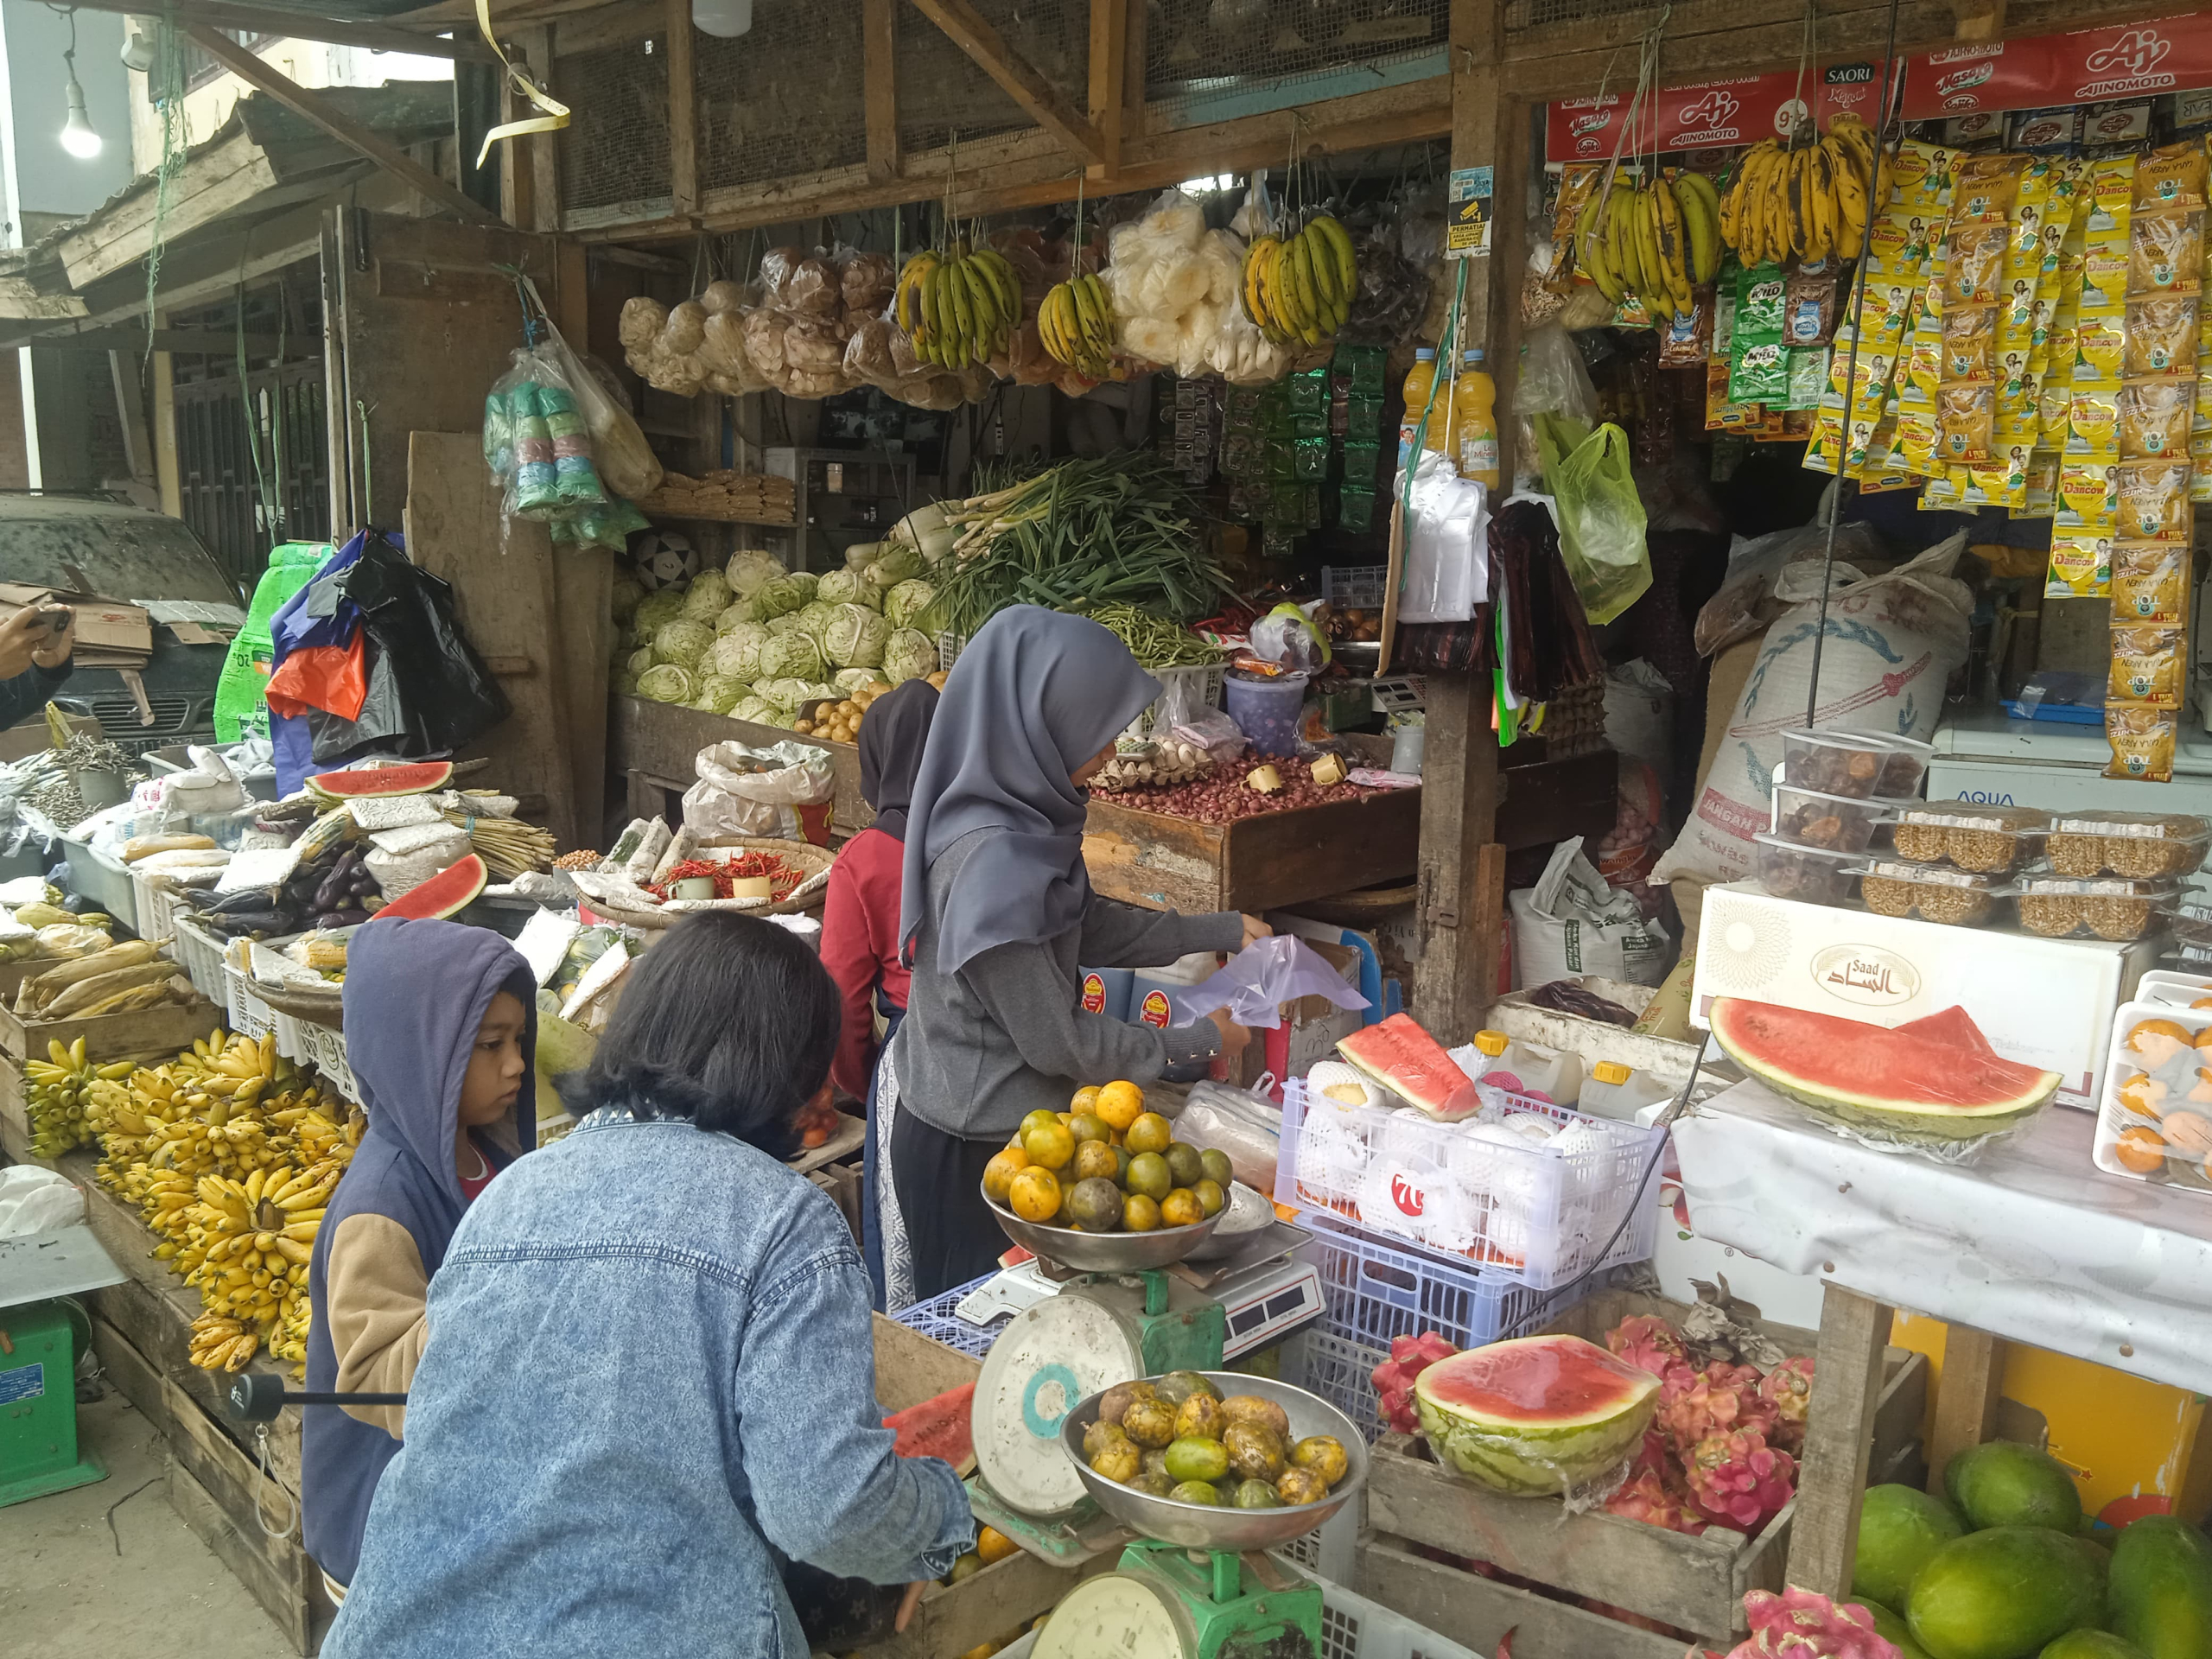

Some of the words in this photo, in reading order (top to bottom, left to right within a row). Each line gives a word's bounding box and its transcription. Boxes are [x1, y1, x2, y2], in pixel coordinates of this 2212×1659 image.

[1827, 68, 1871, 83] SAORI
[2075, 74, 2175, 97] AJINOMOTO
[1671, 129, 1738, 144] AJINOMOTO
[2095, 184, 2133, 196] Danco
[2154, 178, 2185, 191] TOP
[1870, 229, 1906, 243] Dancow
[1833, 367, 1869, 381] Dacow
[2073, 410, 2114, 422] Dancow
[2063, 482, 2106, 495] Dancow
[2135, 512, 2165, 524] TOP
[2054, 553, 2096, 567] Dancow
[2131, 594, 2161, 606] TOP
[2126, 675, 2157, 686] TOP
[2122, 753, 2152, 766] TOP
[1956, 790, 2014, 807] AQUA
[1852, 958, 1880, 976] Saad
